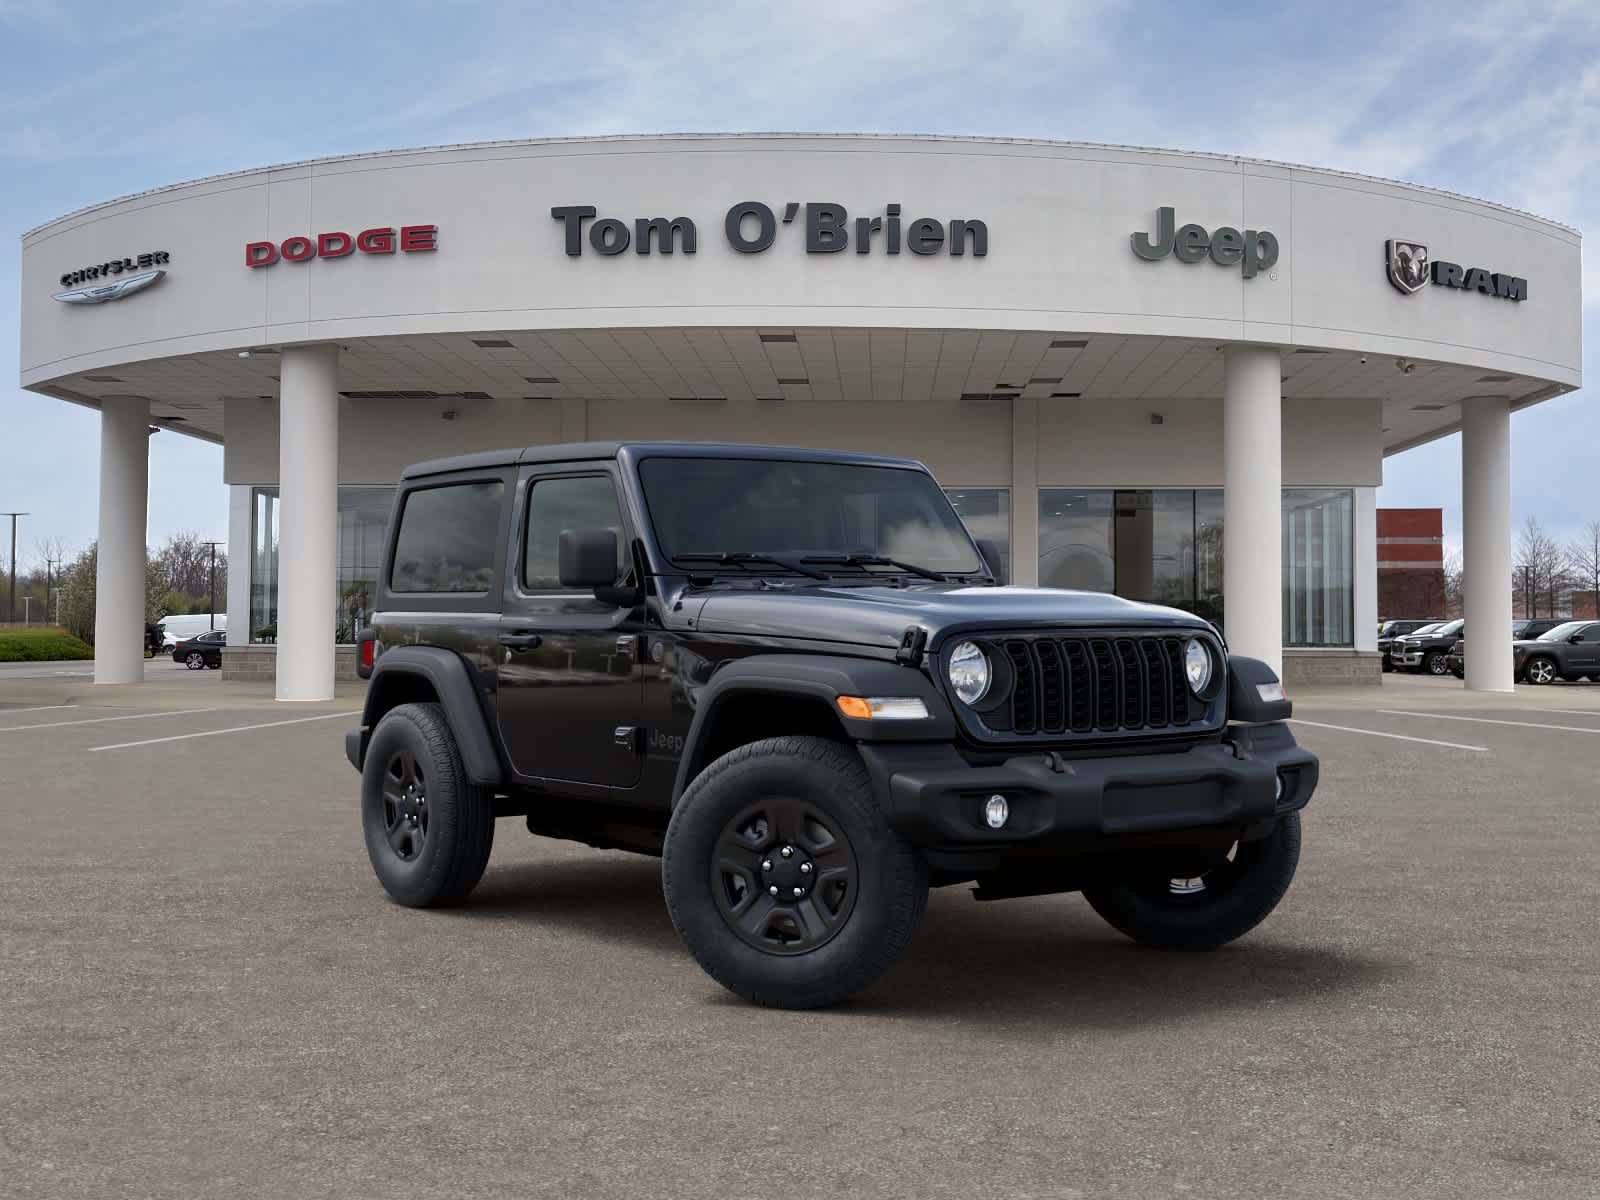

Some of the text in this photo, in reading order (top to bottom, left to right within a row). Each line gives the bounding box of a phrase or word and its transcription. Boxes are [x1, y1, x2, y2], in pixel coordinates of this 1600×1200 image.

[246, 225, 437, 268] DODGE
[551, 201, 988, 256] Tom O'Brien
[1130, 207, 1279, 278] Jeep
[60, 251, 169, 287] CHRYSLER
[1431, 261, 1528, 301] RAM
[649, 728, 684, 753] Jeep
